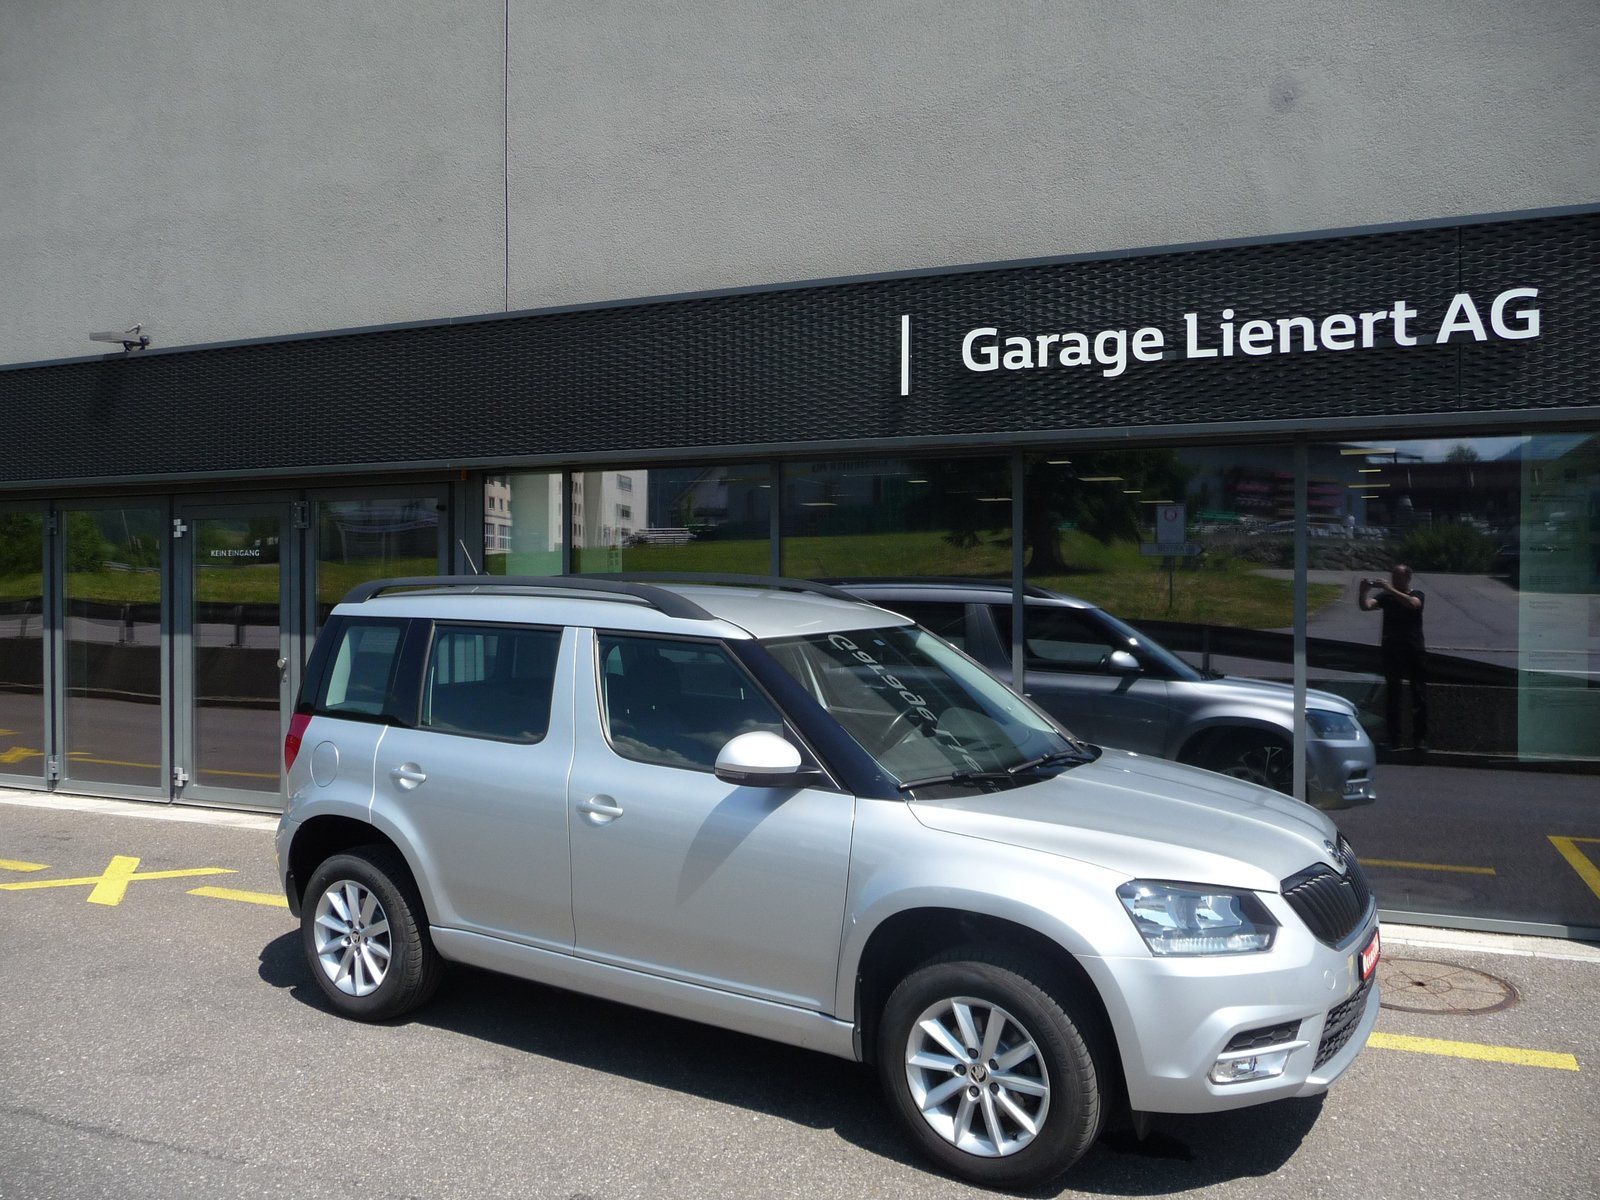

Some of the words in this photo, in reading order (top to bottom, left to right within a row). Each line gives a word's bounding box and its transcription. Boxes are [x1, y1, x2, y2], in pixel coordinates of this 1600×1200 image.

[962, 328, 1165, 378] Garage
[1184, 301, 1417, 359] Lienert
[1437, 288, 1540, 344] AG
[228, 549, 260, 557] EINGANG
